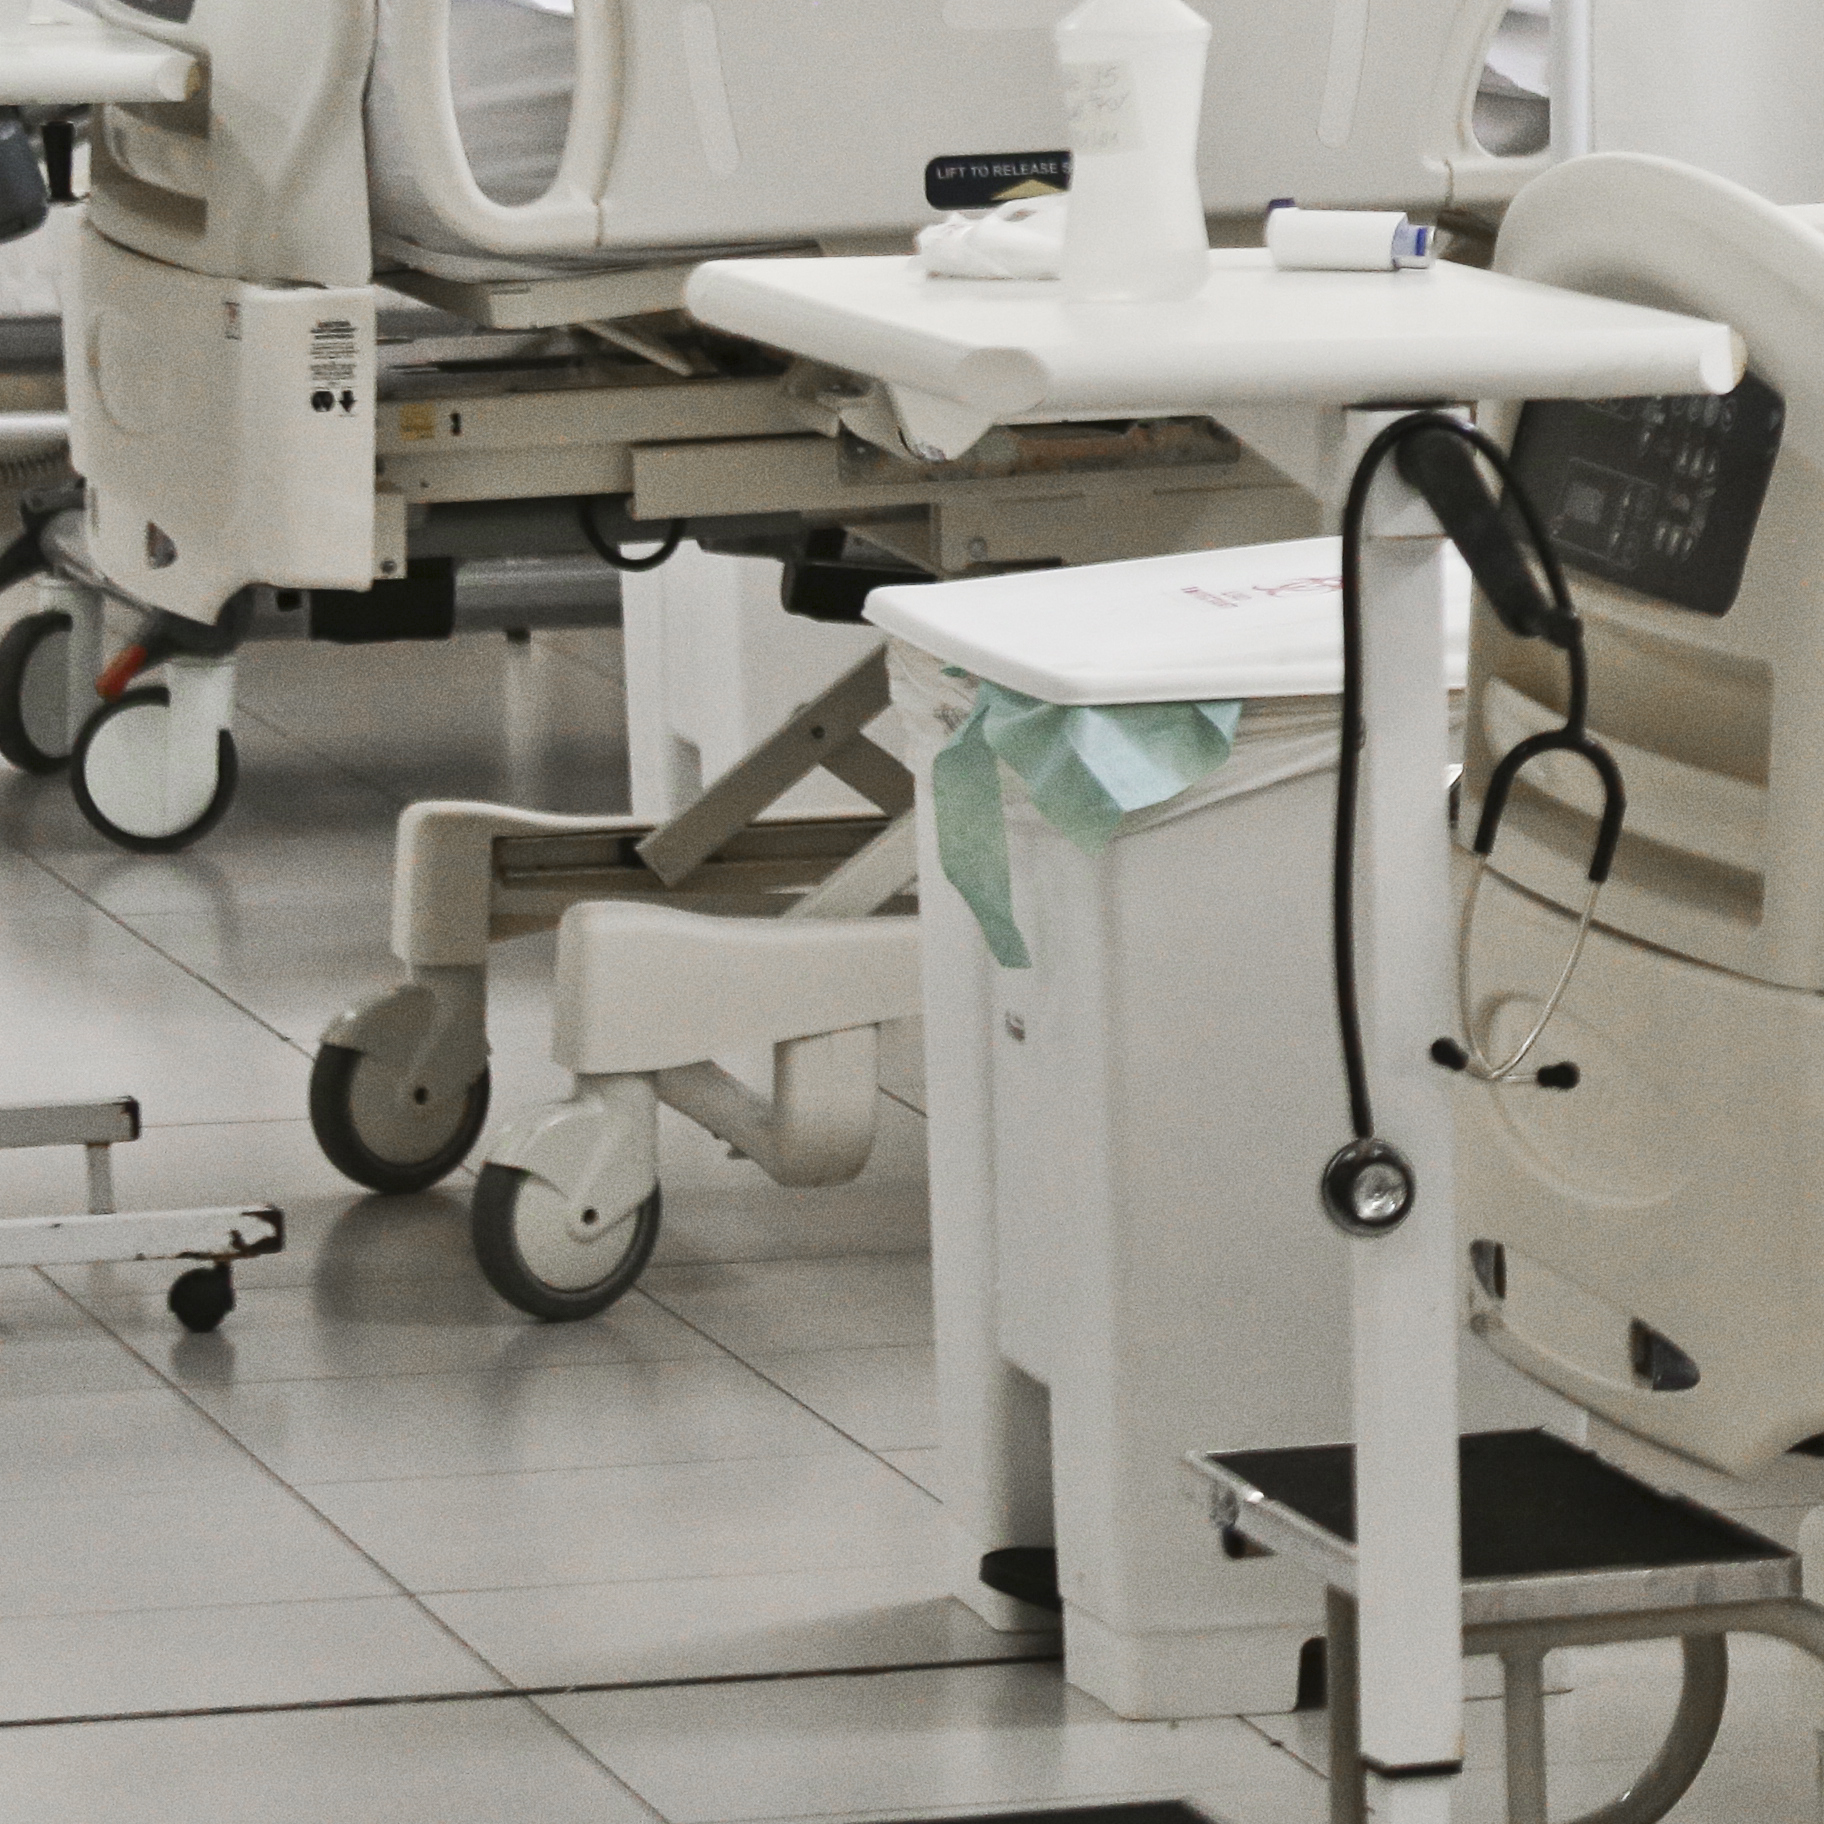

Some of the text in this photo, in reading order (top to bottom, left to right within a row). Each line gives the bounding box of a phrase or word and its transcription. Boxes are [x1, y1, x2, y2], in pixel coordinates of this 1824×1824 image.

[936, 166, 967, 180] LIFT
[970, 165, 988, 178] TO
[992, 162, 1058, 177] RELEASE
